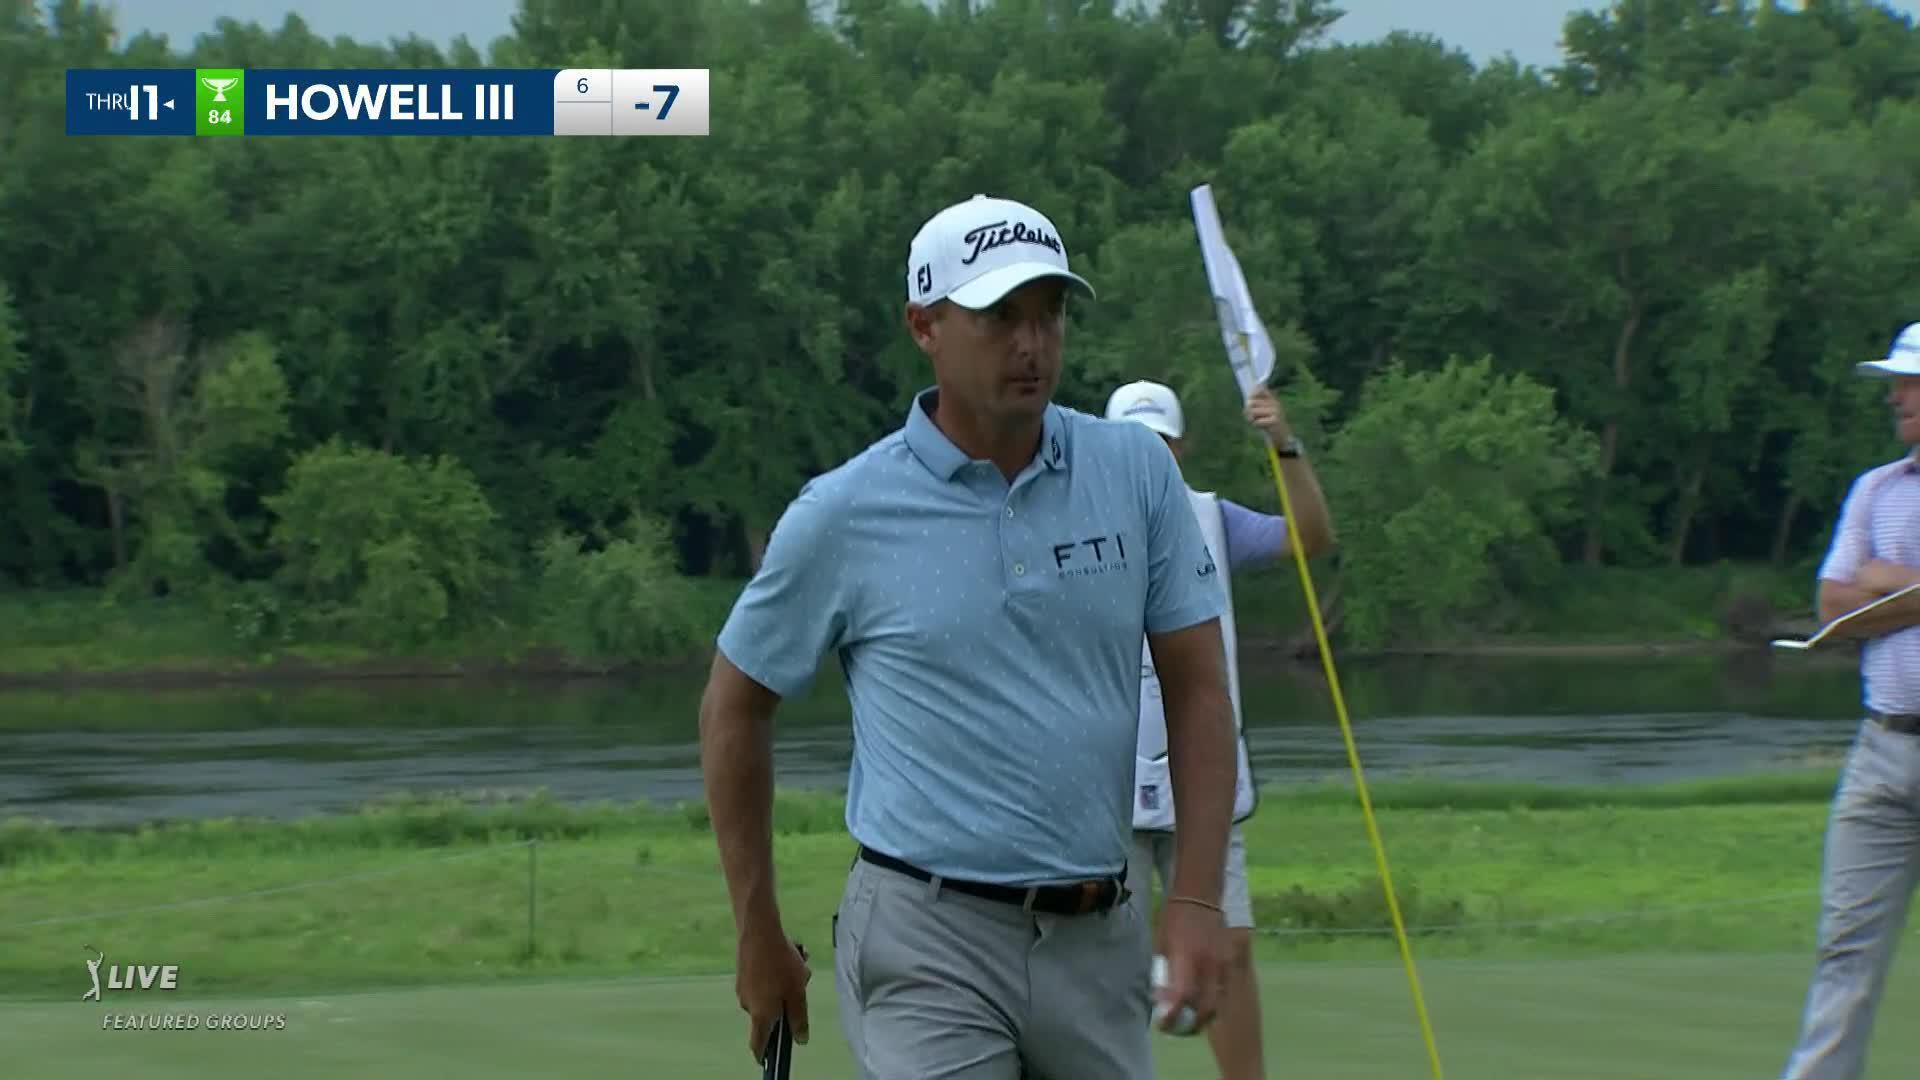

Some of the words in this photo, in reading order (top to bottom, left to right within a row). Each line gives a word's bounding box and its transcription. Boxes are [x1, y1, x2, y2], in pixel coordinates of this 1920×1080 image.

[961, 219, 1061, 265] Titleist
[917, 263, 932, 296] FJ
[1053, 532, 1125, 569] FTI
